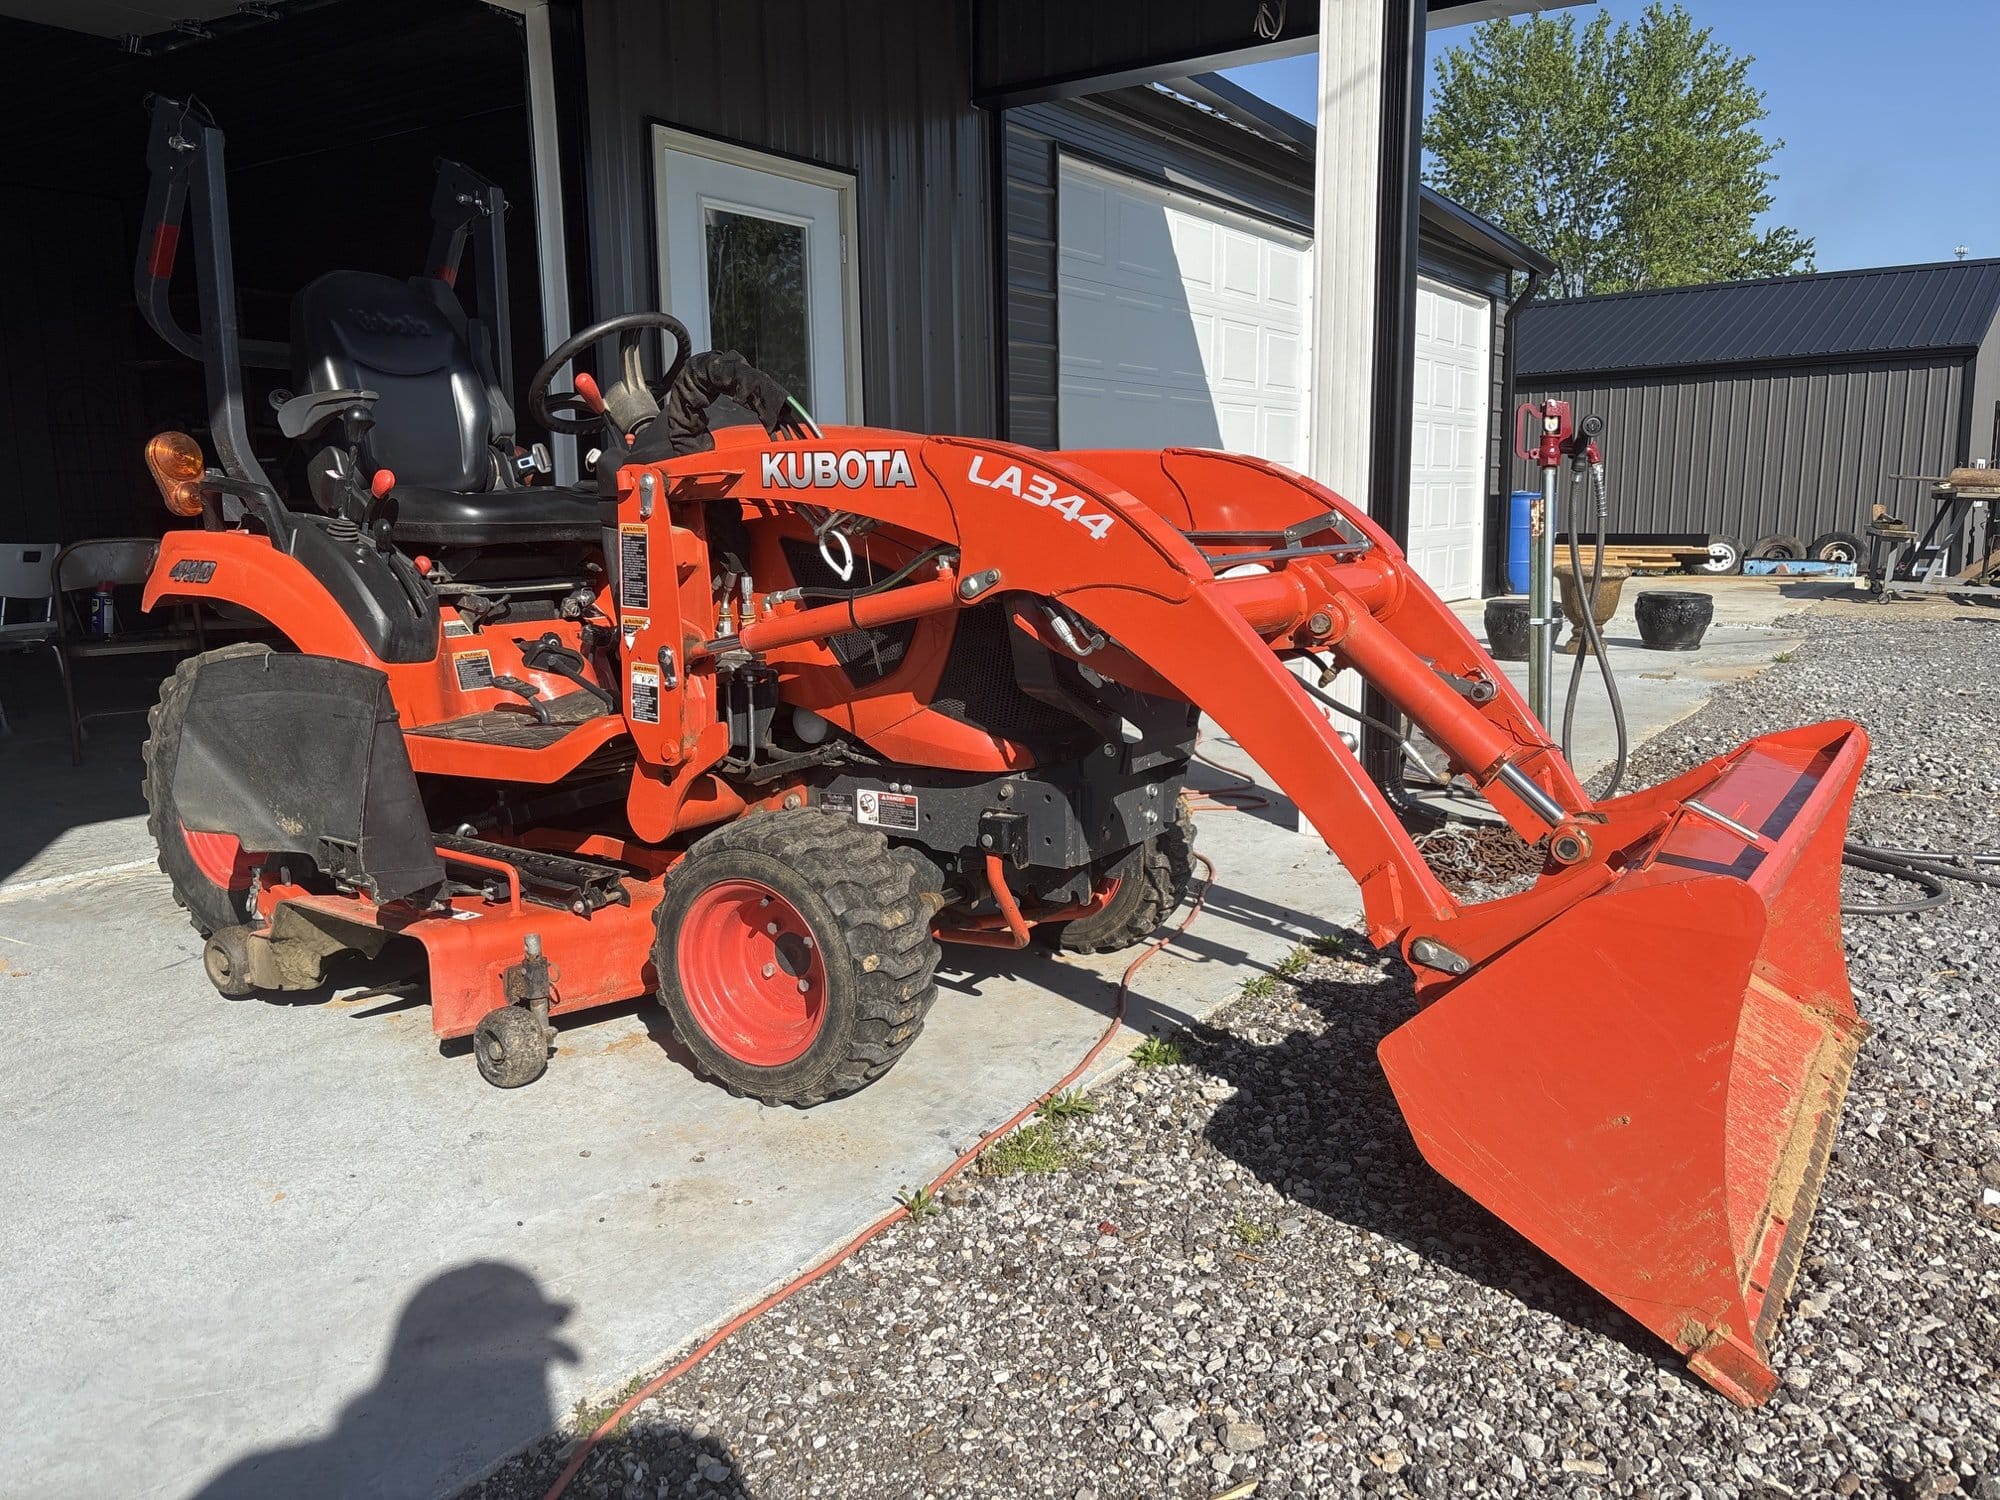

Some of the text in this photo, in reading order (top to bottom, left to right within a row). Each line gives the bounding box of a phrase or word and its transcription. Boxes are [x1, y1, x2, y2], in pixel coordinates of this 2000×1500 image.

[761, 450, 917, 489] KUBOTA
[967, 455, 1115, 541] LA344
[169, 559, 217, 584] 4WD
[637, 665, 657, 674] WARNING
